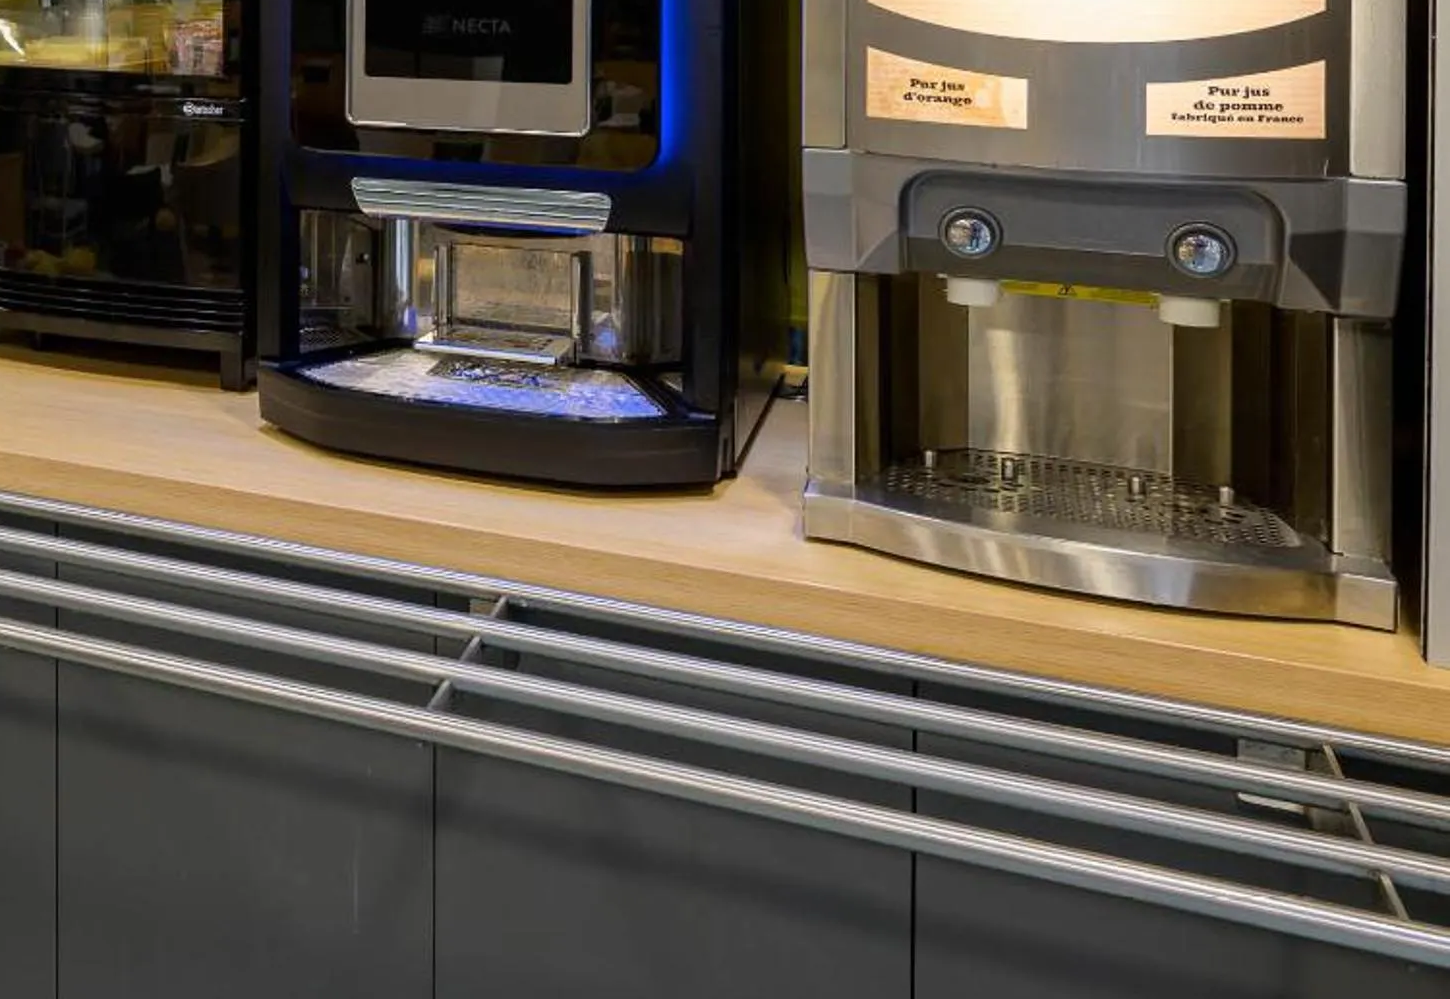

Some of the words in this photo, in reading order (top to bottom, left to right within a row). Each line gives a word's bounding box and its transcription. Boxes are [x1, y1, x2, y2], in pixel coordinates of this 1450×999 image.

[452, 18, 511, 34] NECTA
[910, 78, 939, 90] Pur
[940, 80, 965, 92] jus
[903, 91, 972, 107] d'orange
[1208, 86, 1240, 97] Pur
[1243, 86, 1270, 99] jus
[1193, 100, 1215, 111] de
[1219, 102, 1284, 113] pomme
[1237, 115, 1255, 123] en
[1257, 114, 1304, 124] France
